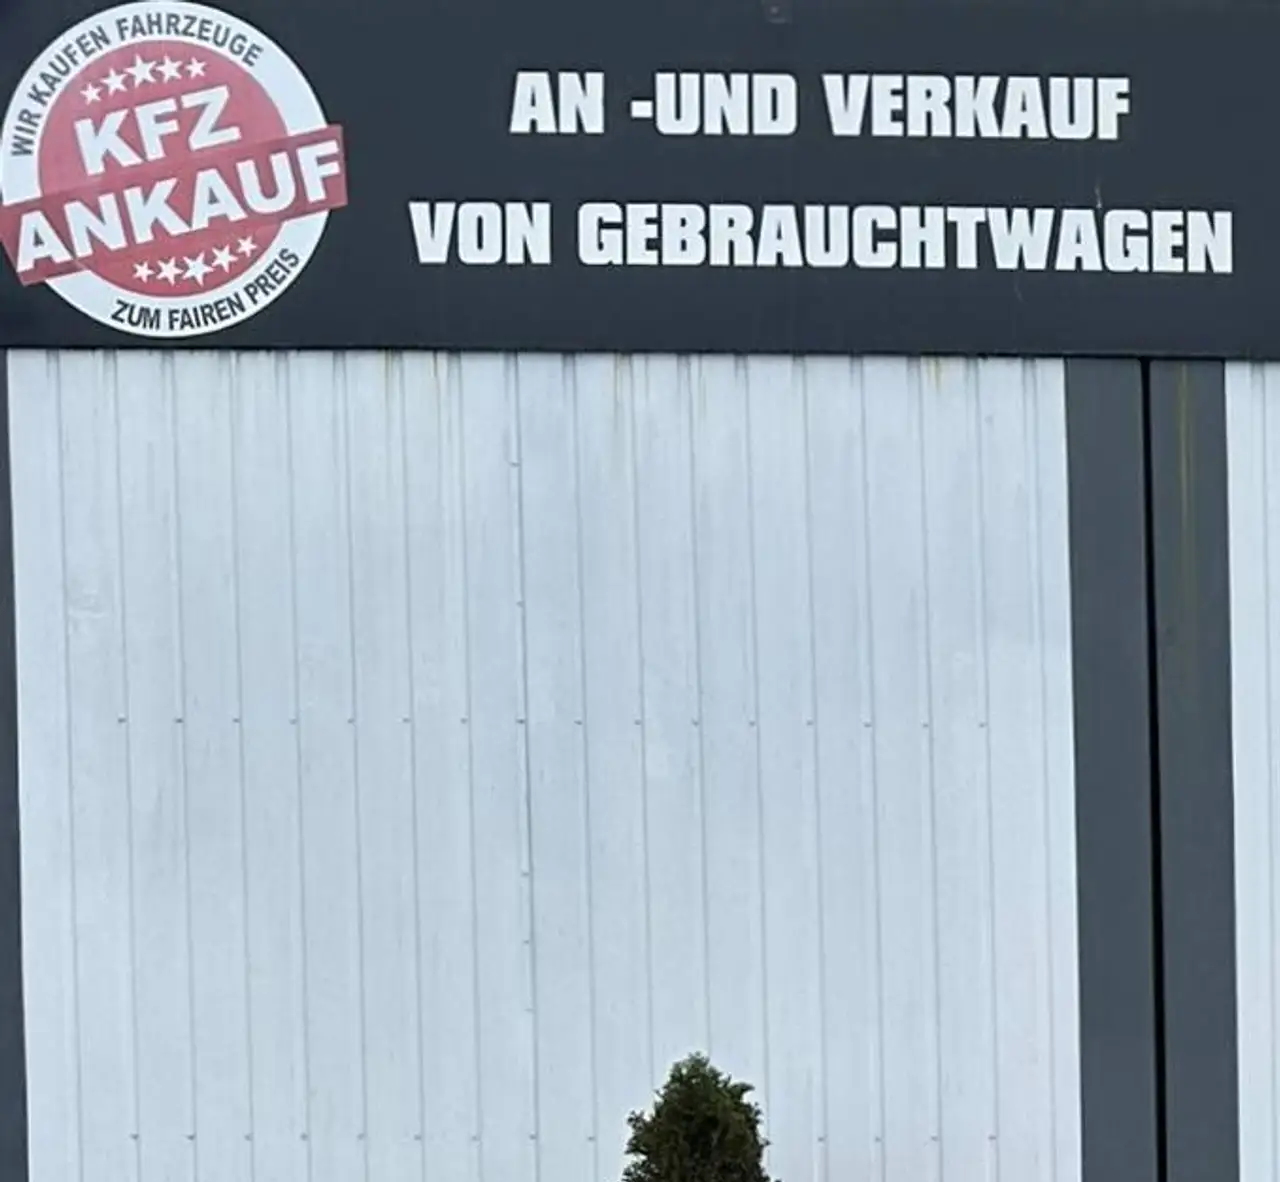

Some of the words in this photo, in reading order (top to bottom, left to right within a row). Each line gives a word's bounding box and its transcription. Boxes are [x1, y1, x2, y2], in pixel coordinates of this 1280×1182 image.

[11, 111, 41, 157] WIR
[28, 25, 111, 107] KAUFEN
[116, 12, 264, 67] FAHRZEUGE
[510, 71, 604, 134] AN
[631, 72, 798, 135] -UND
[822, 73, 1131, 140] VERKAUF
[74, 85, 241, 176] KFZ
[16, 140, 340, 272] ANKAUF
[408, 202, 551, 265] VON
[578, 202, 1234, 273] GEBRAUCHTWAGEN
[111, 299, 161, 330] ZUM
[168, 300, 246, 331] FAIREN
[247, 248, 300, 305] PREIS
